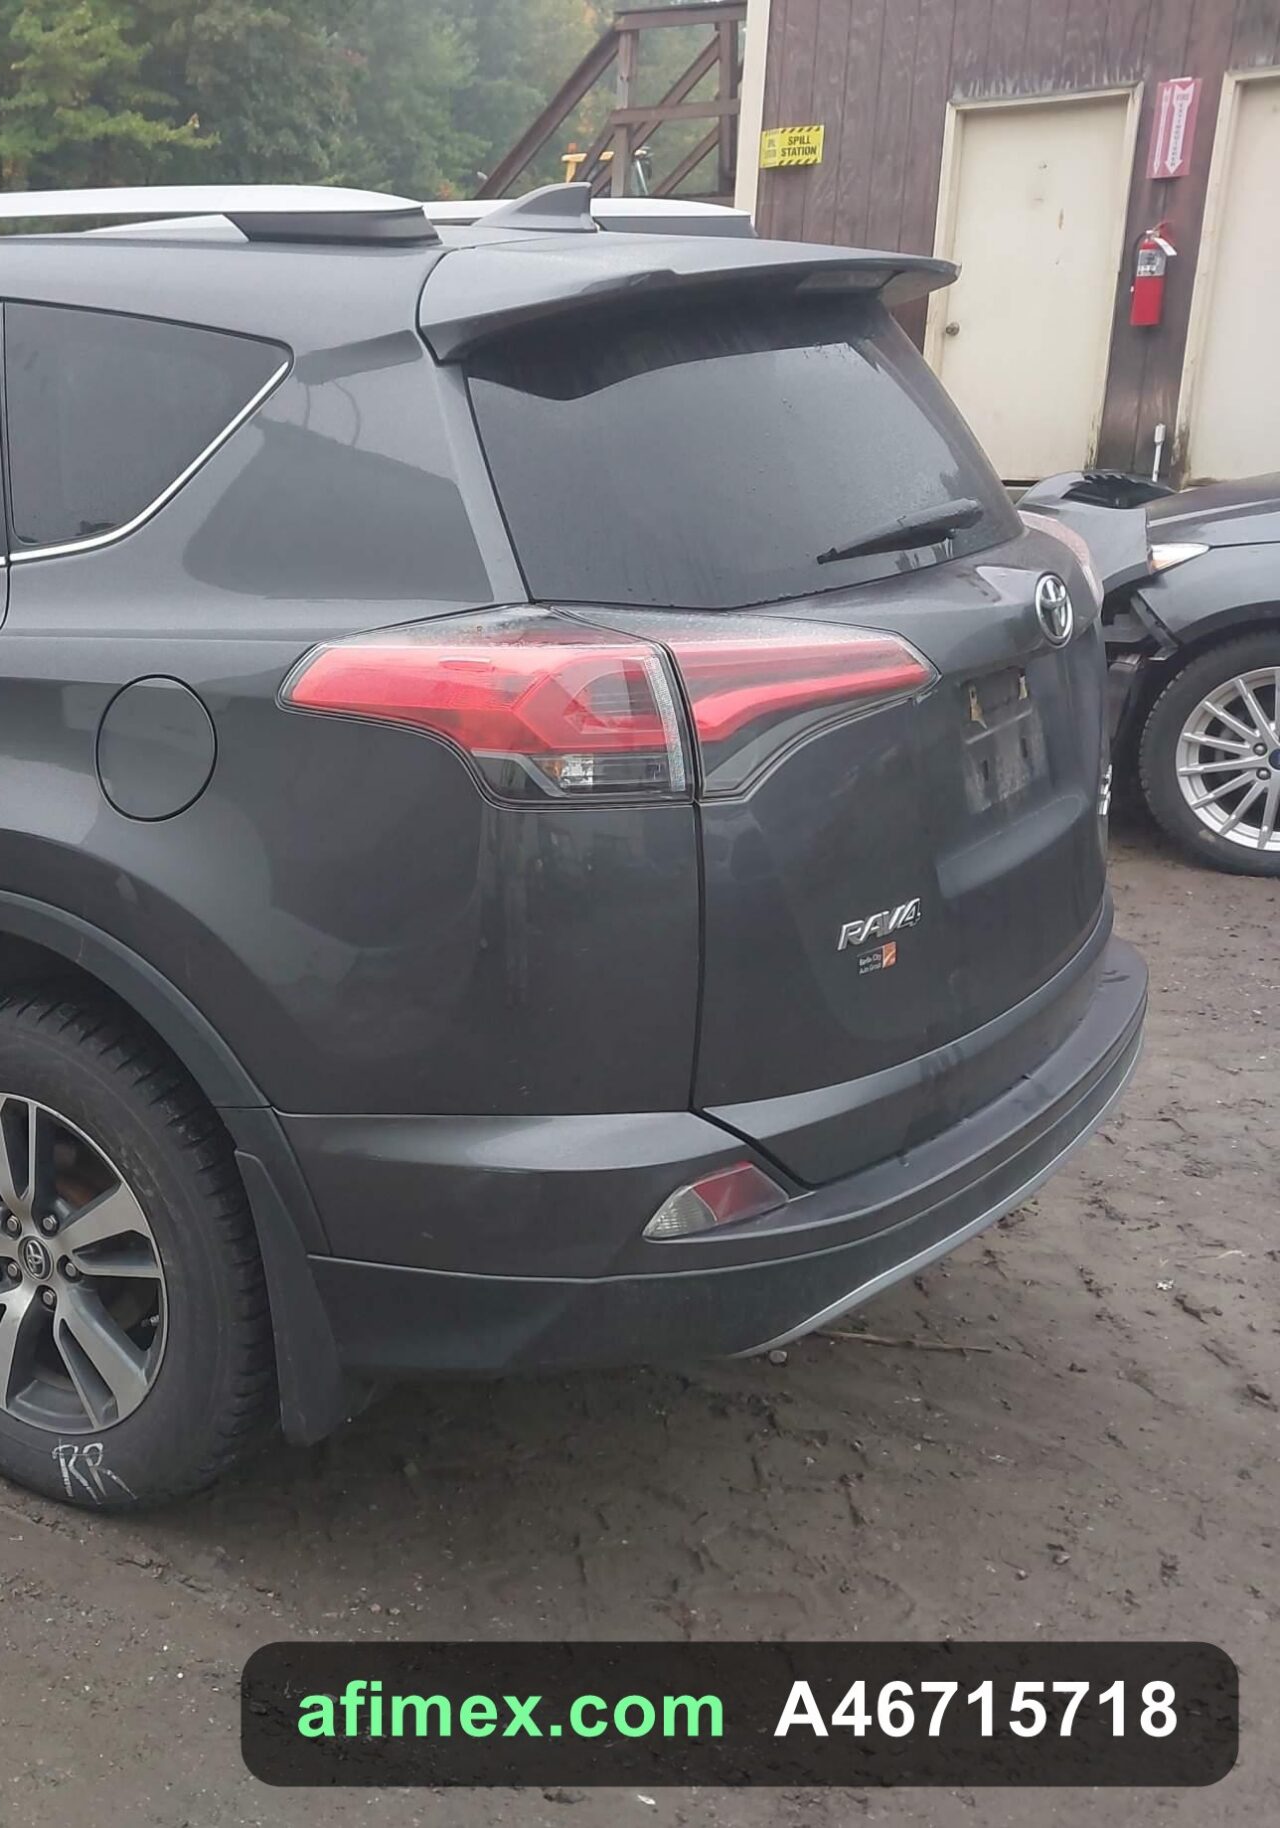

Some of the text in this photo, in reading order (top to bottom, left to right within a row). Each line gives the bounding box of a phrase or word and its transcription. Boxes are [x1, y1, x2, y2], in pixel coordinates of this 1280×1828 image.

[781, 146, 817, 157] STATION
[787, 135, 810, 145] SPILL
[837, 898, 921, 951] RAV4
[52, 1438, 138, 1505] RR
